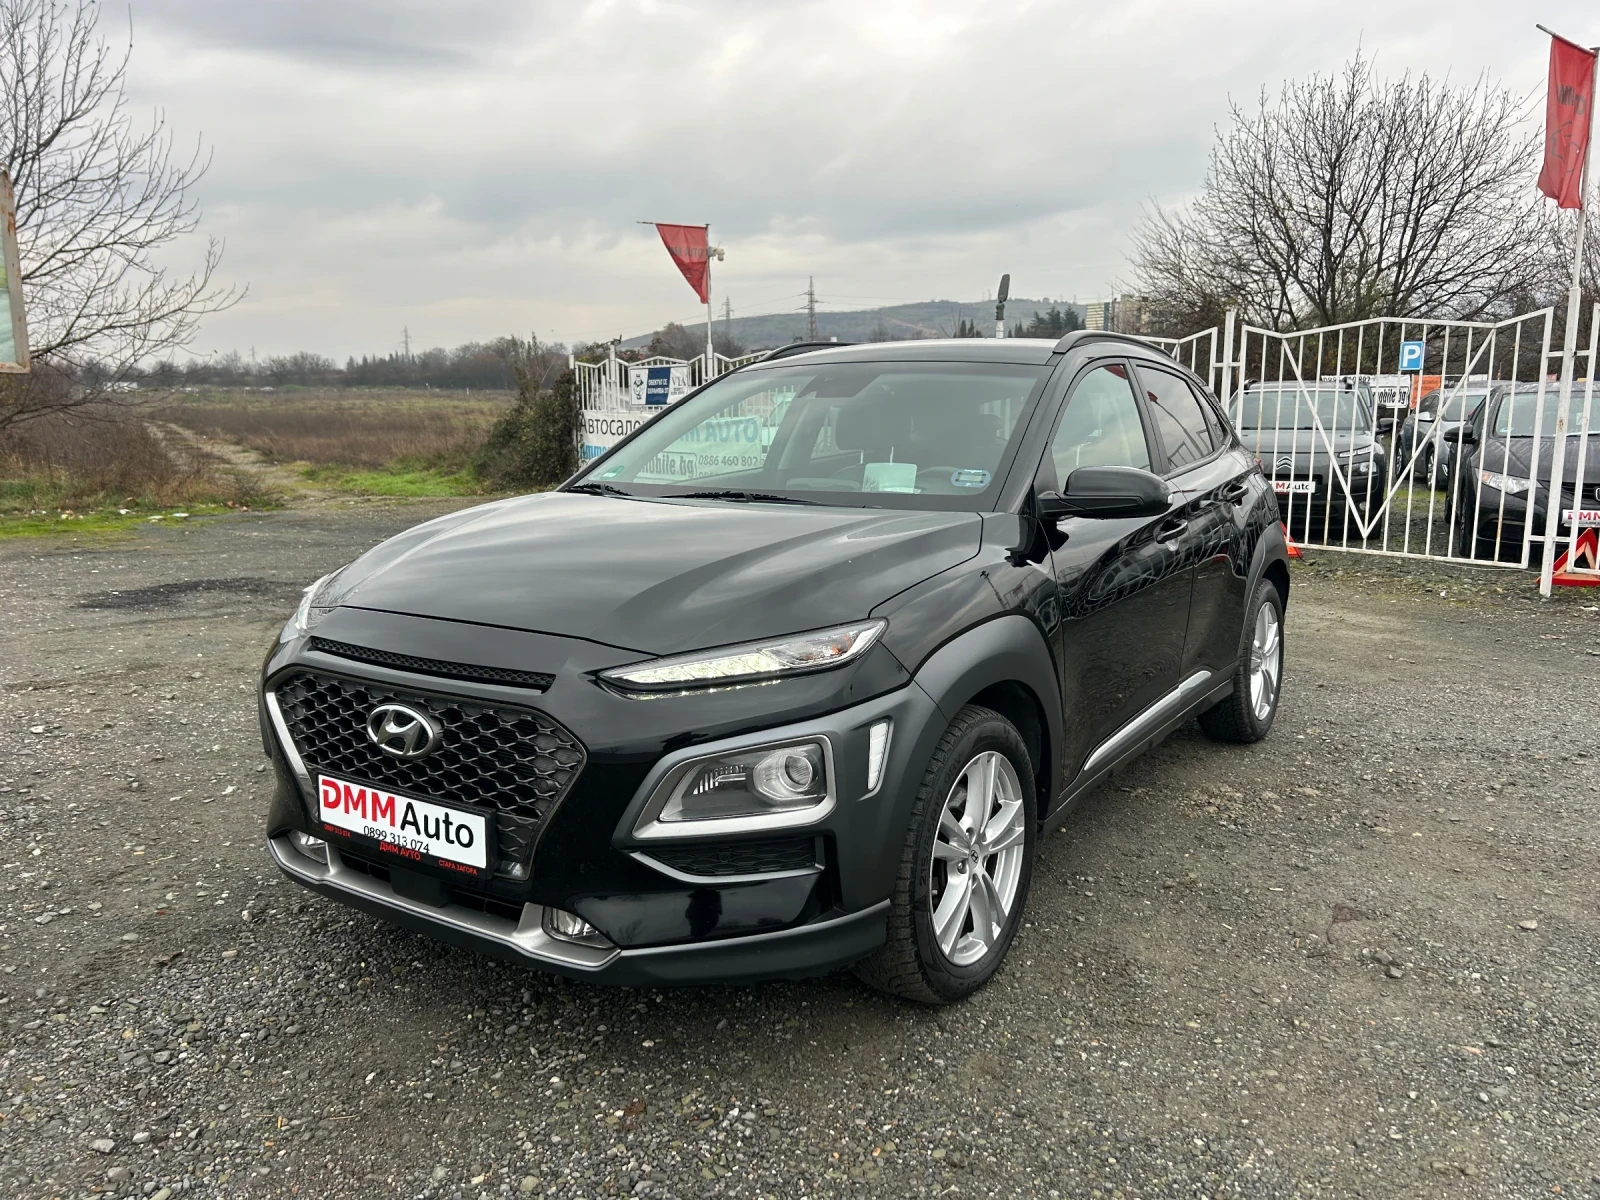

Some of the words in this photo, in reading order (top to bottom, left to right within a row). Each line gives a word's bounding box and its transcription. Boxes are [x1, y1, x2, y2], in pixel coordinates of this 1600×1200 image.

[1402, 345, 1420, 367] P
[705, 418, 759, 443] AUTO
[698, 455, 719, 466] 0886
[721, 455, 739, 466] 460
[741, 456, 758, 467] 802
[363, 825, 387, 841] 0899
[390, 833, 407, 848] 313
[410, 839, 430, 854] 074
[380, 841, 398, 854] ДММ
[400, 847, 421, 860] АУТО
[439, 859, 455, 870] СТАРА
